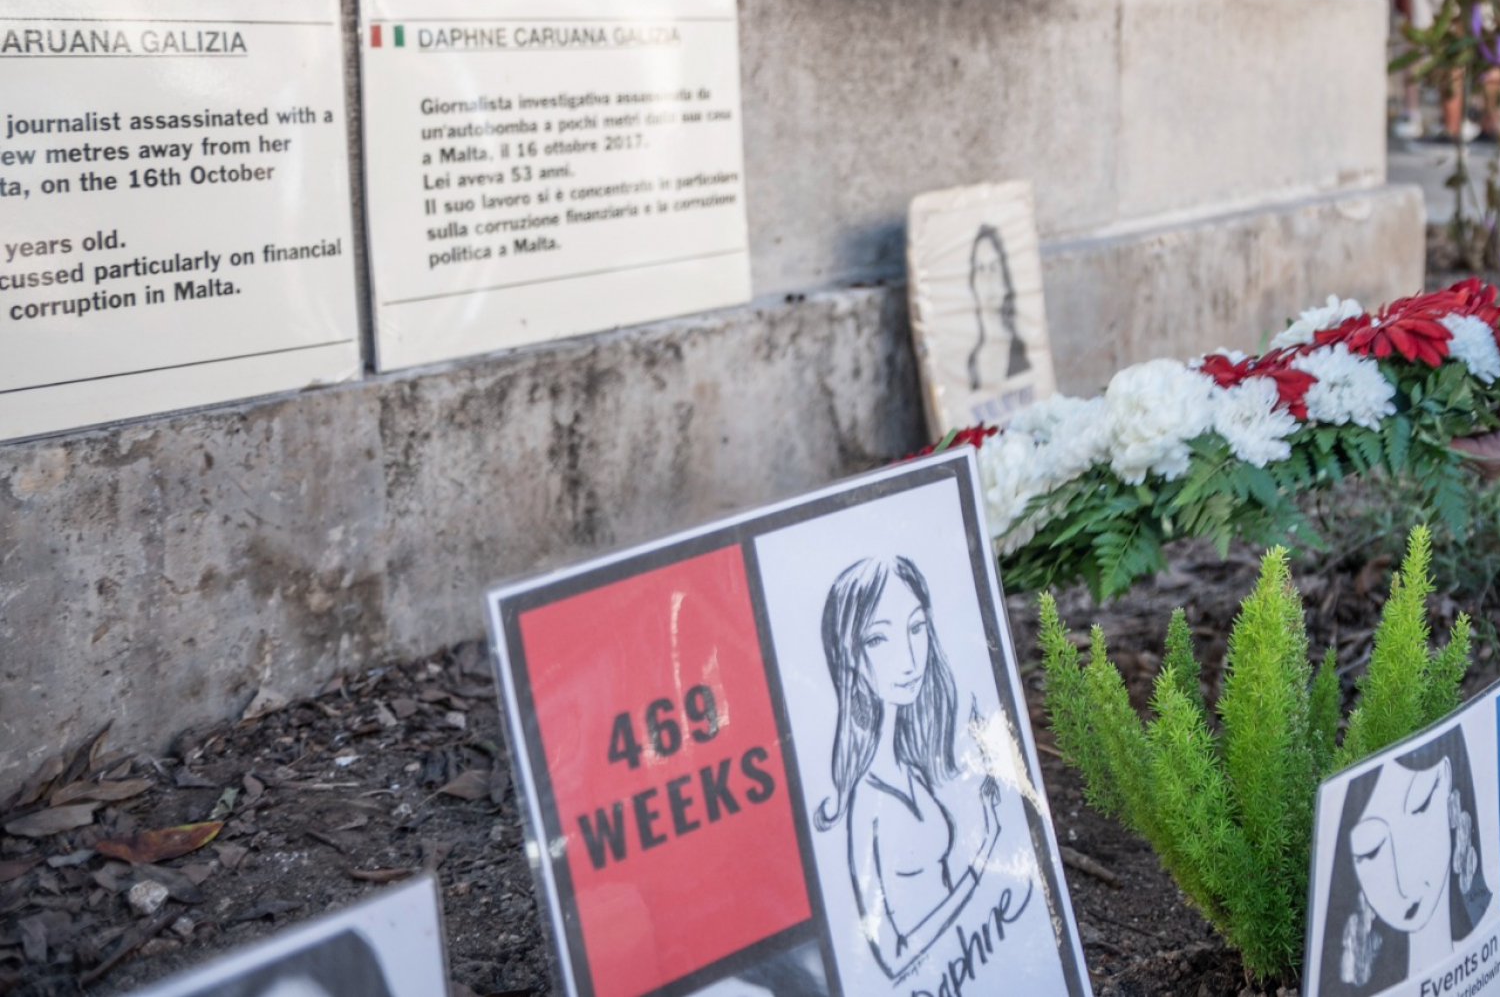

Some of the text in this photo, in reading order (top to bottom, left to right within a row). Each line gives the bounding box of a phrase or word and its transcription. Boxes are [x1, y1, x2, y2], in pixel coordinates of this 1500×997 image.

[1, 29, 248, 53] ARUANA GALIZIA
[418, 28, 508, 49] DAPHNE
[514, 27, 607, 48] CARUANA
[421, 96, 512, 116] Giornalista
[518, 92, 609, 110] investigativa
[6, 106, 334, 139] journalist assassinated with a
[421, 120, 537, 141] un'autobomba
[544, 120, 552, 132] a
[558, 115, 597, 134] pochi
[602, 114, 639, 130] metri
[0, 135, 291, 165] ew metres away from her
[422, 133, 649, 165] a Malta, il 16 ottobre 2017.
[40, 177, 70, 194] on
[79, 171, 117, 192] the
[129, 167, 181, 189] 16th
[190, 163, 274, 185] October
[423, 163, 575, 191] Lei aveva 53 anni.
[425, 198, 436, 215] Il
[444, 200, 475, 214] suo
[482, 192, 531, 211] lavoro
[537, 188, 549, 203] si
[570, 180, 652, 201] concentrato
[658, 178, 669, 190] in
[427, 222, 468, 241] sulla
[475, 213, 559, 235] corruzione
[566, 204, 638, 224] finanziaria
[644, 205, 651, 215] e
[657, 202, 668, 214] la
[5, 229, 126, 262] years old.
[94, 250, 221, 285] particularly
[230, 249, 255, 267] on
[263, 238, 342, 263] financial
[429, 237, 562, 270] politica a Malta.
[9, 278, 241, 321] corruption in Malta.
[607, 683, 720, 770] 469
[576, 745, 775, 871] WEEKS
[911, 877, 1033, 997] aphne
[1420, 952, 1478, 997] Events
[1481, 935, 1498, 963] on
